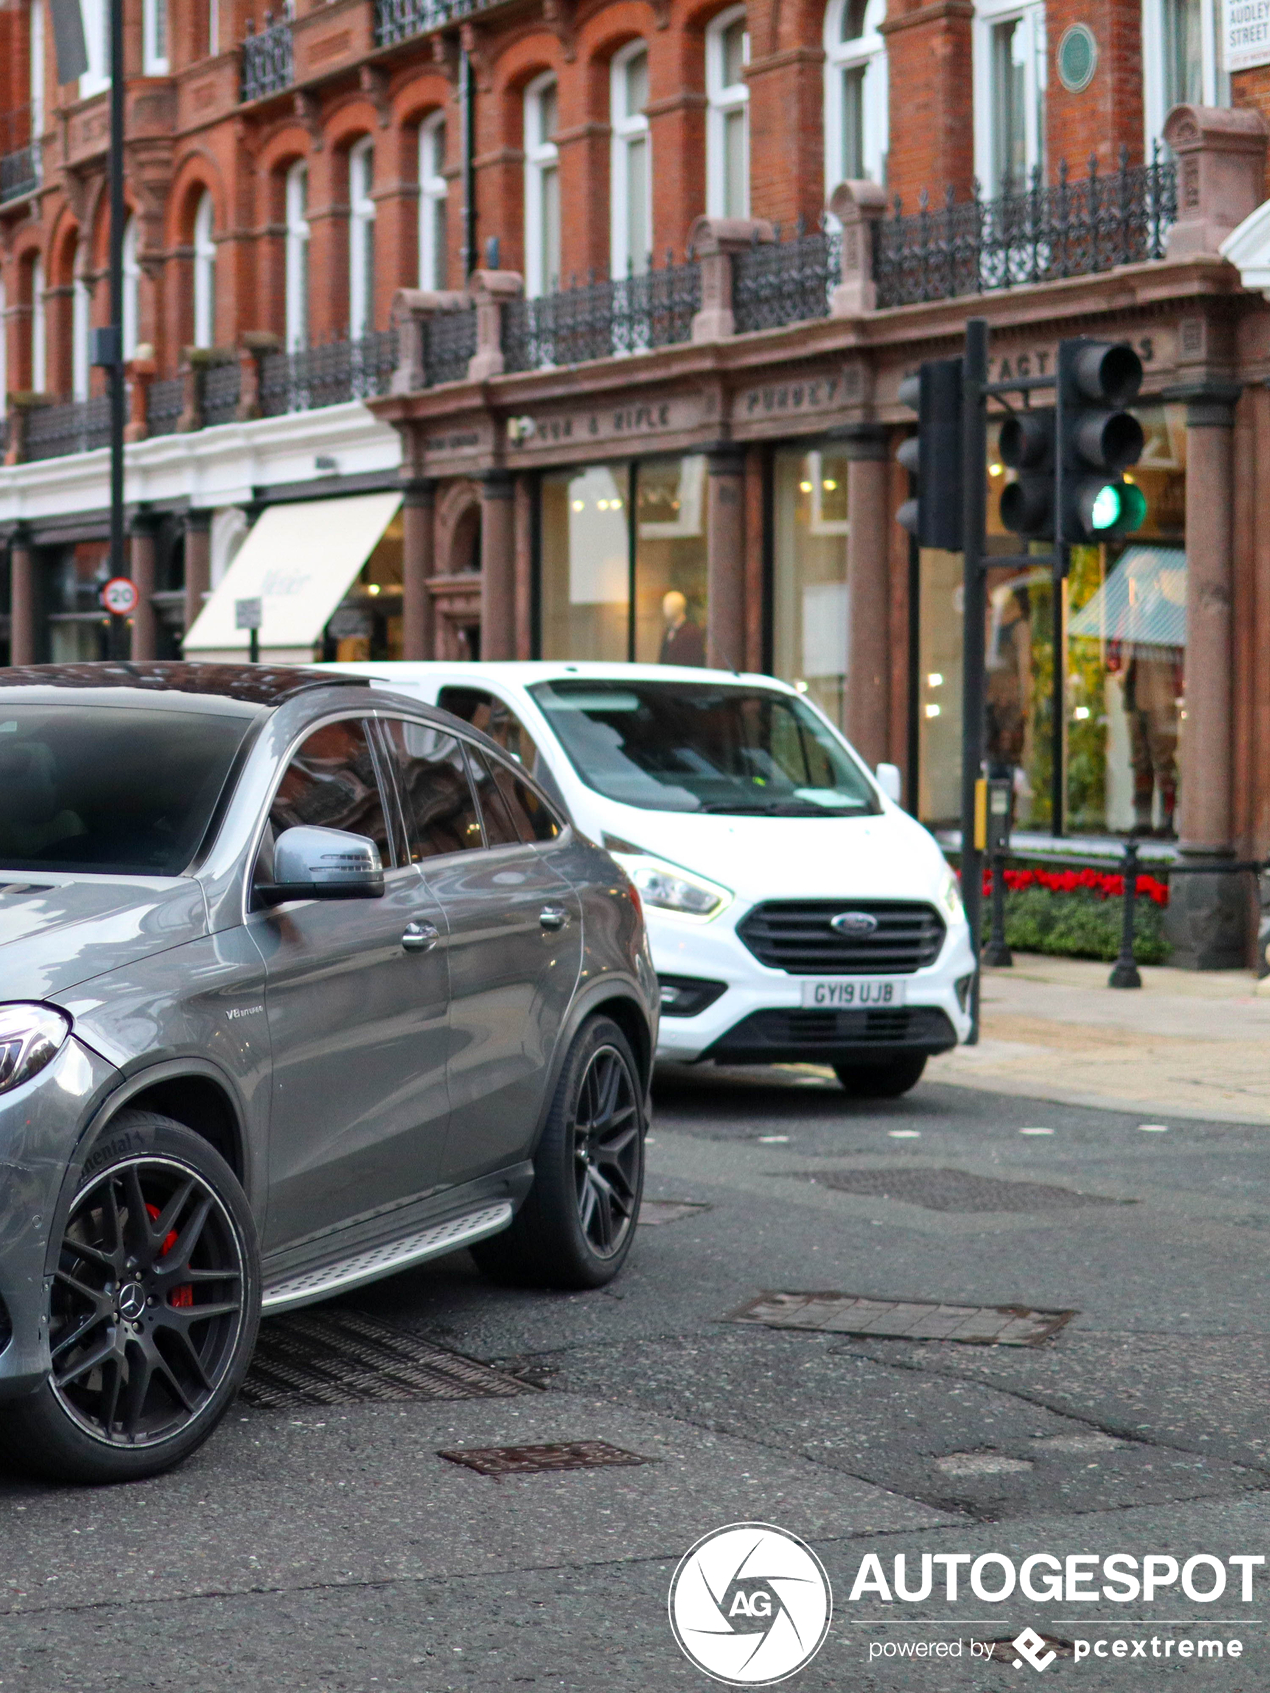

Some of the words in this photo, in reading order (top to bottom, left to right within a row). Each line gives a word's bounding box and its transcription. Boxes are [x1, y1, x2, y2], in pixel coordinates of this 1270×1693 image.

[1230, 2, 1270, 24] AUDLEY
[1230, 22, 1268, 47] STREET
[747, 378, 838, 413] PURDEY
[613, 403, 669, 432] RIFLE
[110, 588, 133, 603] 20
[814, 983, 856, 1004] GY19
[859, 983, 893, 1004] UJB
[81, 1132, 133, 1176] nental
